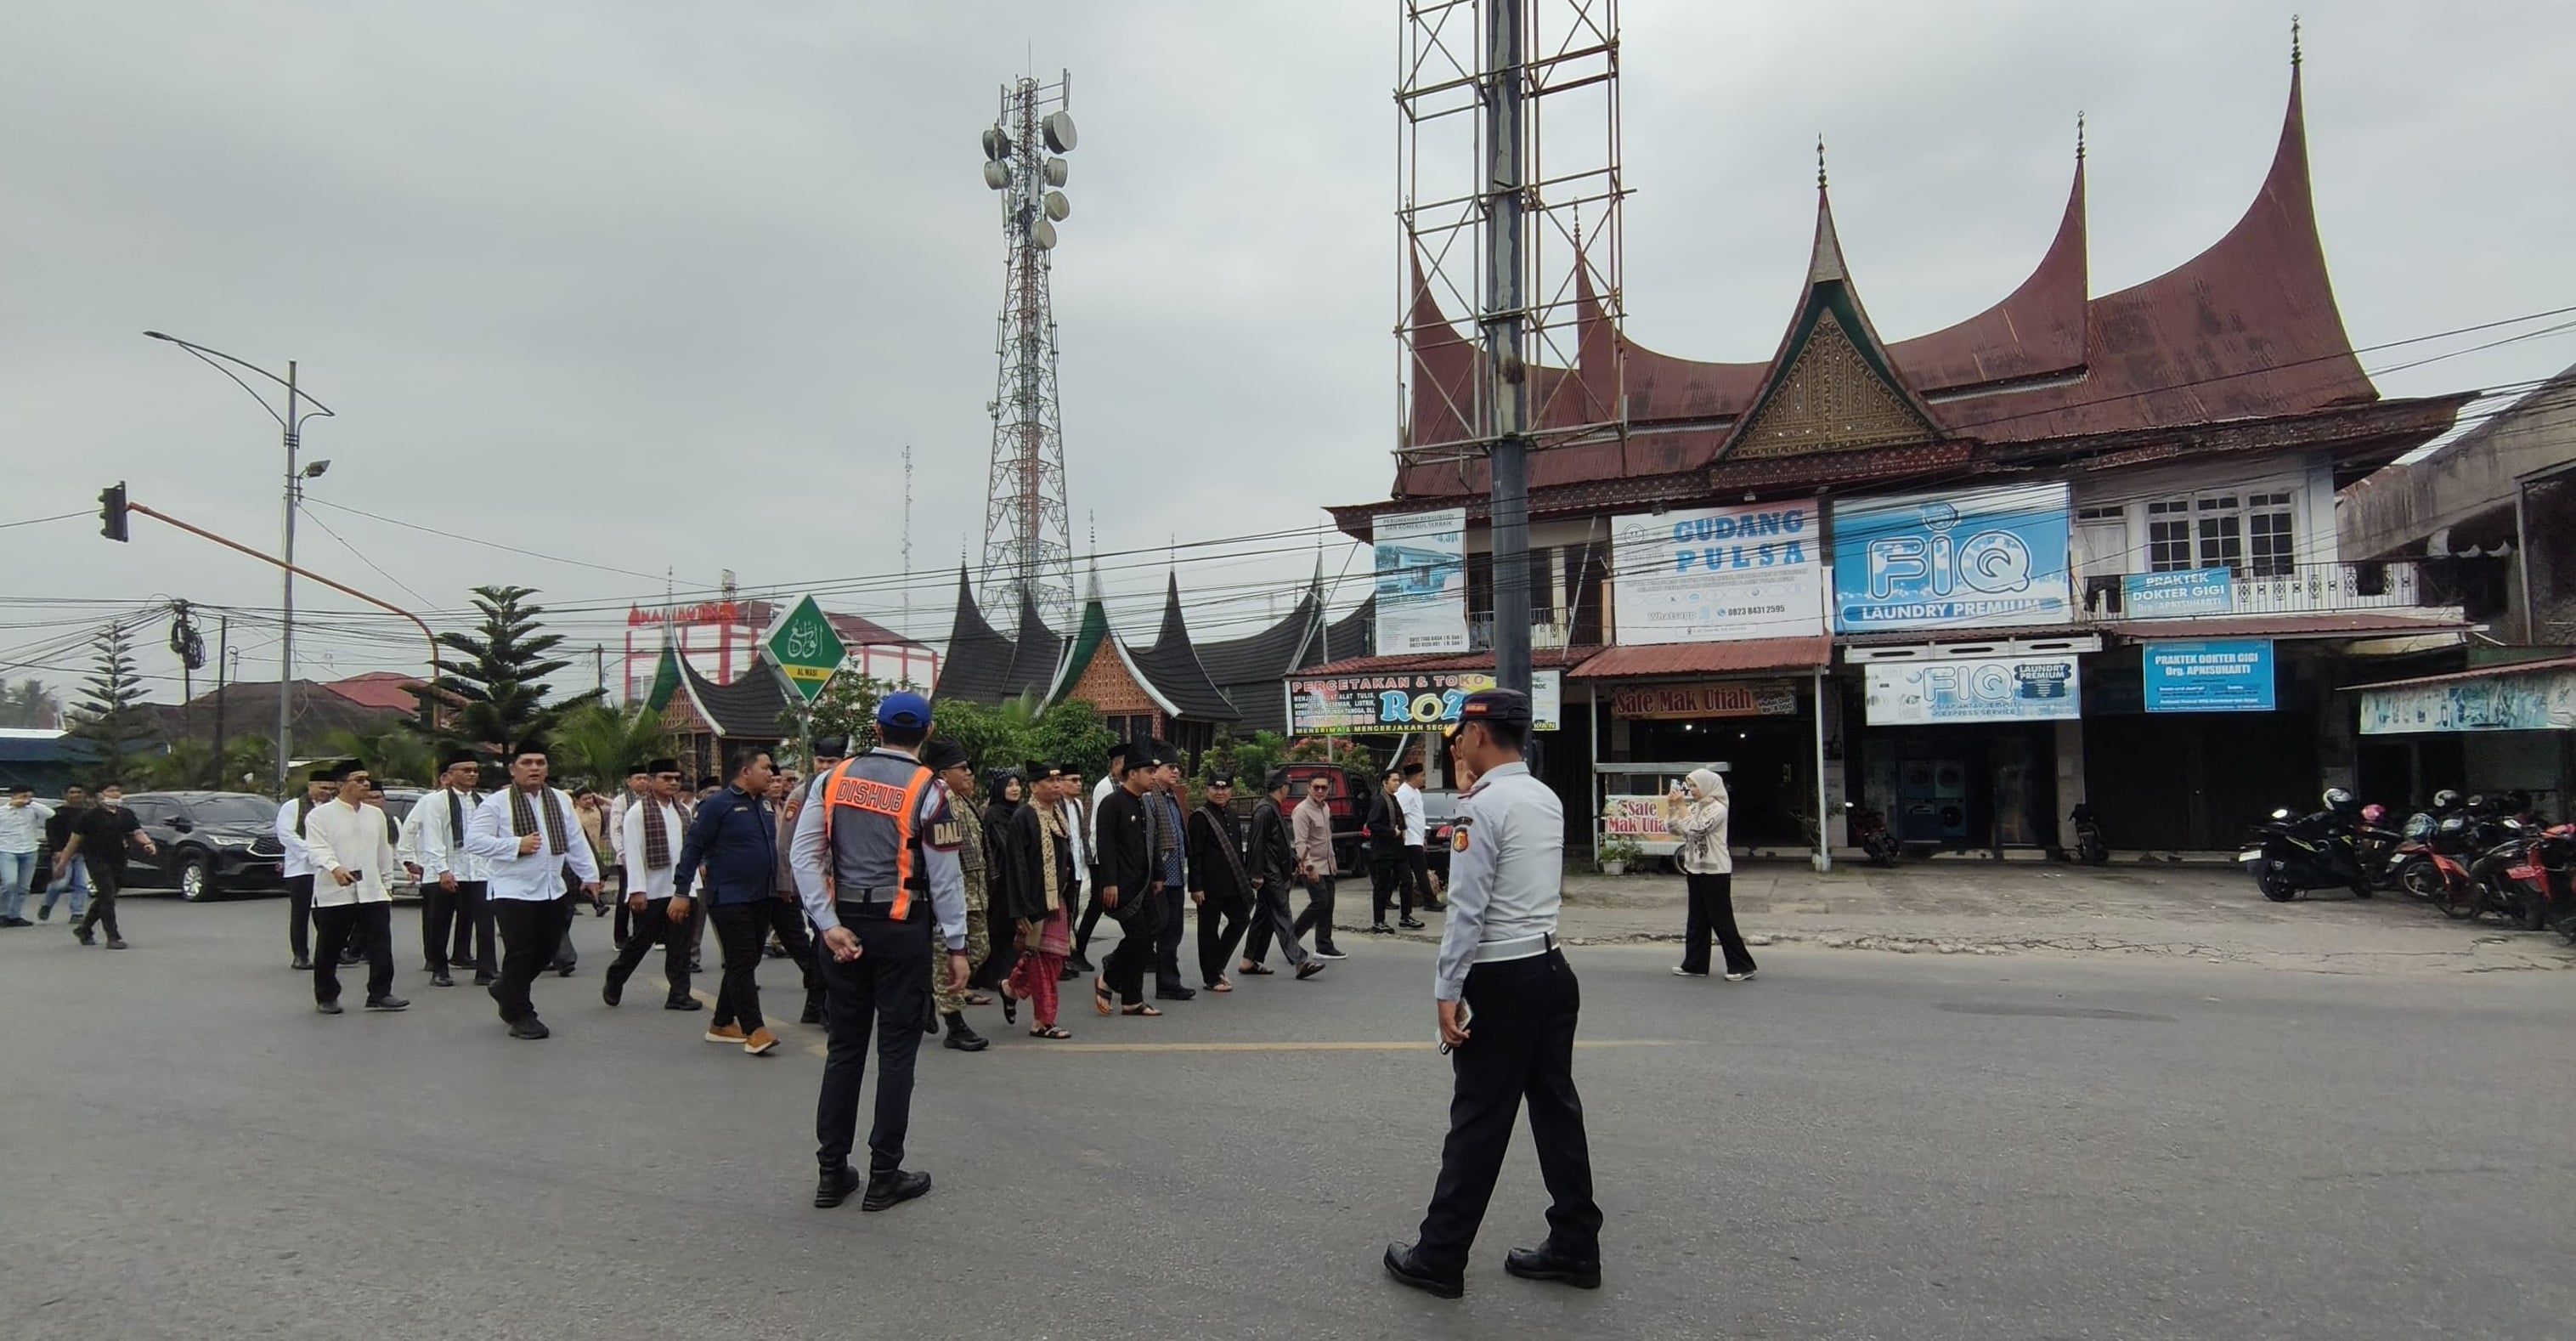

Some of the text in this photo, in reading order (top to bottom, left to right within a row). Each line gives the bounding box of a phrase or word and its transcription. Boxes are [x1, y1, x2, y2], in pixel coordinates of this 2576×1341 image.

[1674, 510, 1805, 544] GUDANG
[1676, 540, 1805, 573] PULSA
[2145, 572, 2210, 588] PRAKTEK
[2133, 585, 2224, 601] DOKTER GIGI
[1728, 607, 1747, 616] 0823
[1861, 598, 2039, 620] LAUNDRY PREMIUM
[2155, 654, 2197, 665] PRAKTEK
[2238, 653, 2258, 663] GIGI
[1292, 675, 1485, 693] PERCETAKAN & TOKO
[1339, 693, 1353, 701] ALAT
[1616, 687, 1753, 713] Sate Mak Utiah
[1354, 724, 1424, 733] MENGERJAKAN
[836, 779, 906, 812] DISHUB
[1628, 801, 1657, 817] Sate
[1608, 818, 1667, 833] Mak Utia
